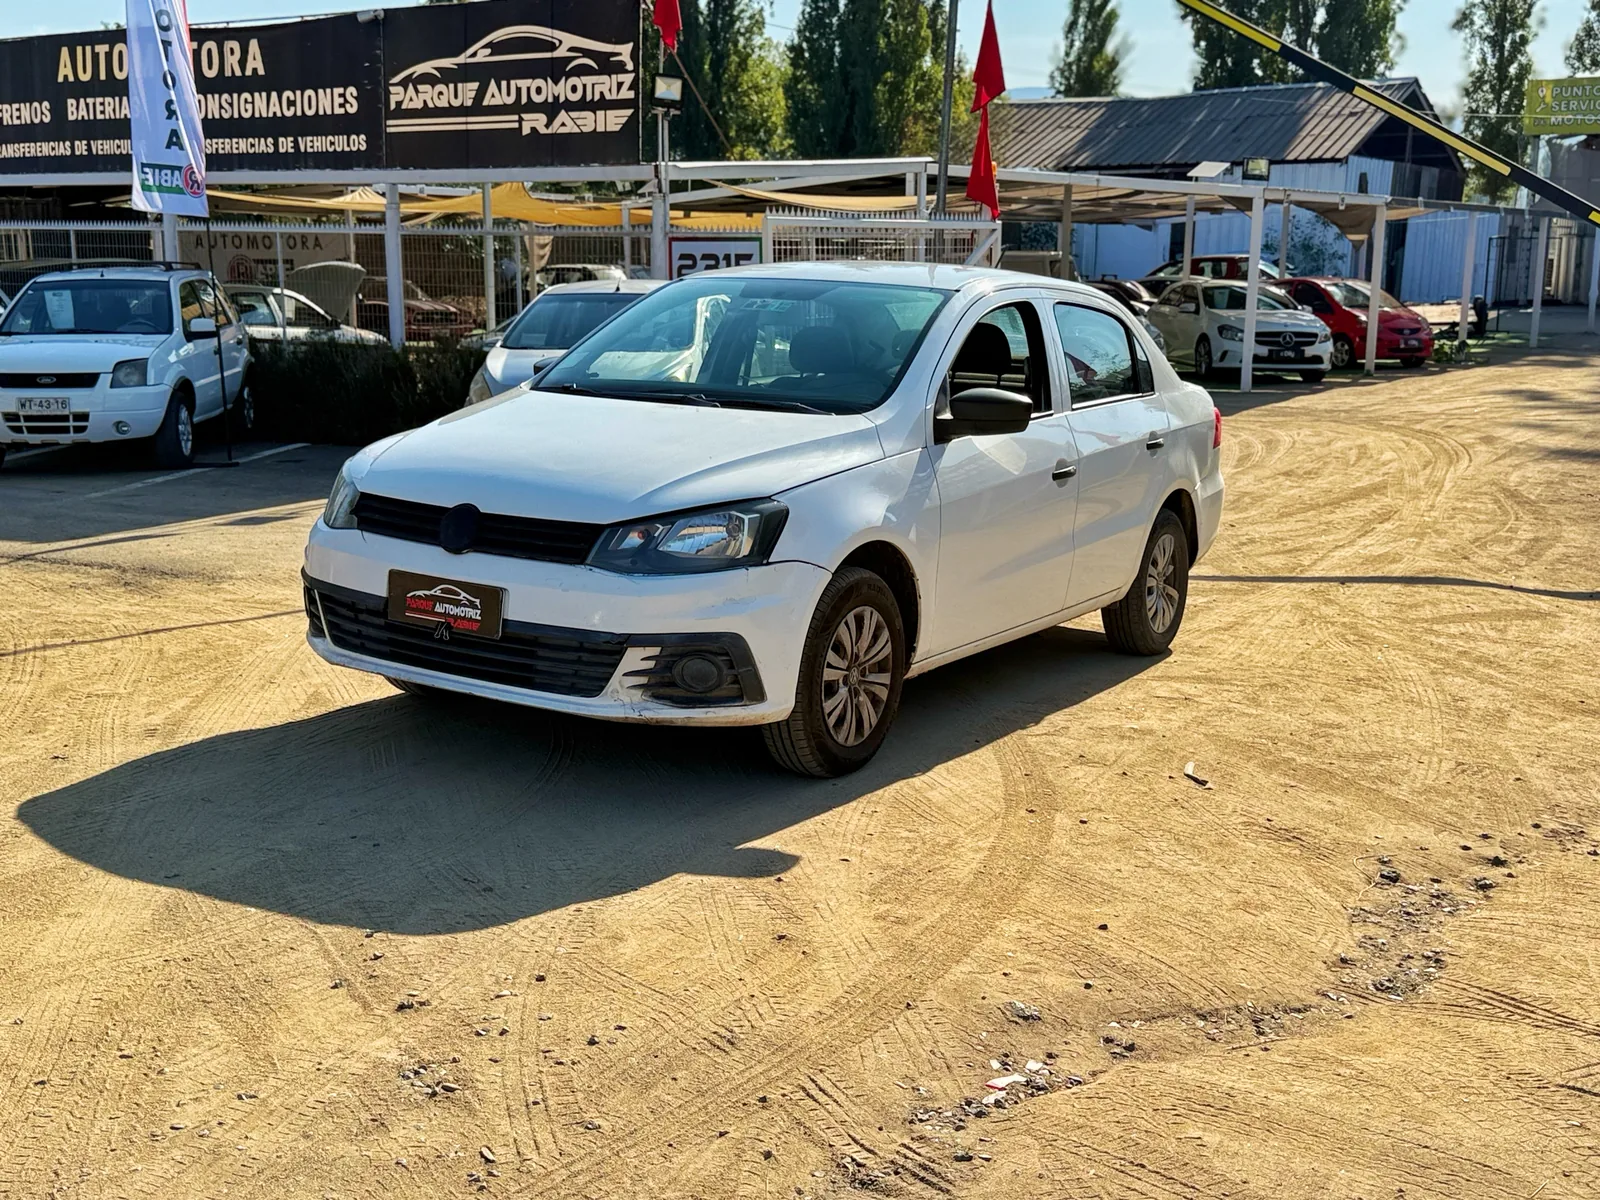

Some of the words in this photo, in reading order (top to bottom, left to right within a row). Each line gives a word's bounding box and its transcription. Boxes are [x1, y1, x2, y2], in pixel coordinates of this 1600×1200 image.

[57, 38, 266, 82] AUTOORA
[67, 96, 131, 121] BATERIA
[197, 86, 358, 120] ONSIGNACIONES
[389, 81, 480, 111] PARQUE
[482, 73, 635, 106] AUTOMOTRIZ
[521, 109, 635, 136] RABIE
[0, 141, 71, 158] ANSFERENCIAS
[75, 140, 88, 155] DE
[90, 139, 133, 155] VEHICUL
[205, 137, 275, 154] SFERENCIAS
[279, 136, 295, 153] DE
[298, 134, 367, 153] VEHICULOS
[194, 233, 323, 250] AUTOMOORA
[434, 601, 481, 620] AUTOMOTRIZ
